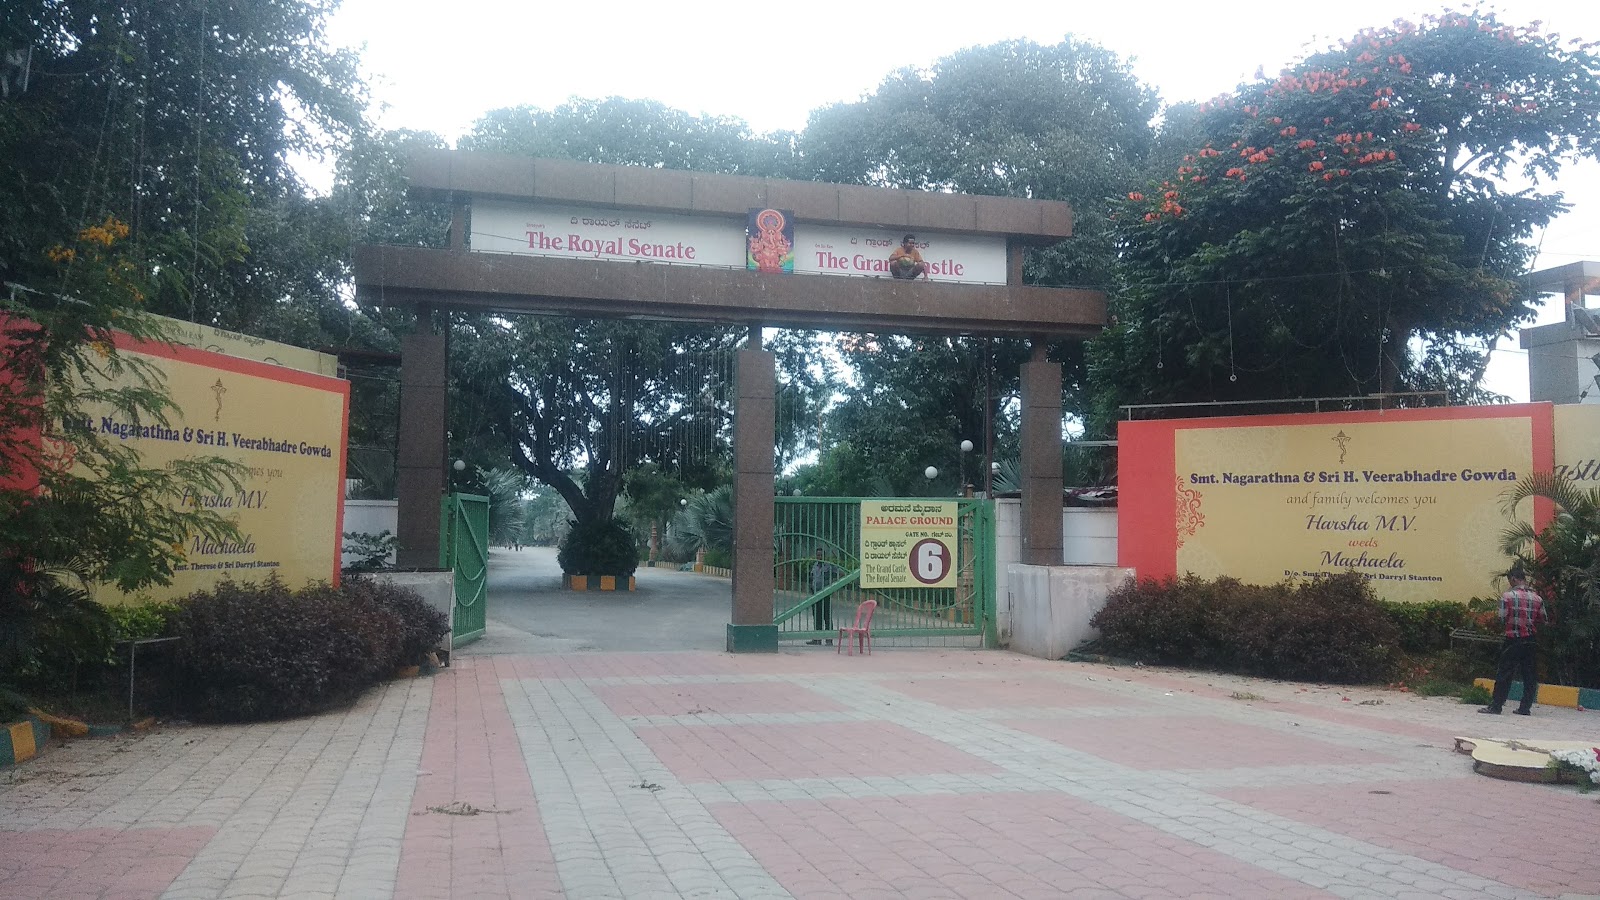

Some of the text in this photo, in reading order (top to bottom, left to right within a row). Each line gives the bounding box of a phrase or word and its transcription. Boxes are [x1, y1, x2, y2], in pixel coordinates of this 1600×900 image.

[525, 231, 696, 260] The Royal Senate
[815, 251, 964, 276] The Gra astle
[101, 416, 180, 441] Nagarathna
[183, 427, 193, 442] &
[196, 429, 214, 446] Sri
[217, 431, 229, 447] H.
[232, 433, 298, 454] Veerabhadre
[299, 441, 331, 458] Gowda
[266, 468, 283, 483] you
[1190, 468, 1517, 486] Smt. Nagarathna & Sri H. Veerabhadre Gowda
[238, 490, 268, 509] M.V.
[1286, 491, 1437, 510] and family welcomes you
[866, 516, 954, 525] PALACE GROUND
[1306, 514, 1417, 531] Harsha M.V.
[1348, 537, 1378, 548] weds
[224, 561, 234, 569] Sri
[918, 542, 943, 580] 6
[1321, 550, 1406, 568] Machaela
[866, 564, 875, 573] The
[877, 564, 891, 573] Grand
[866, 574, 875, 582] The
[1379, 573, 1406, 582] Darryl
[1408, 574, 1443, 582] Stanton
